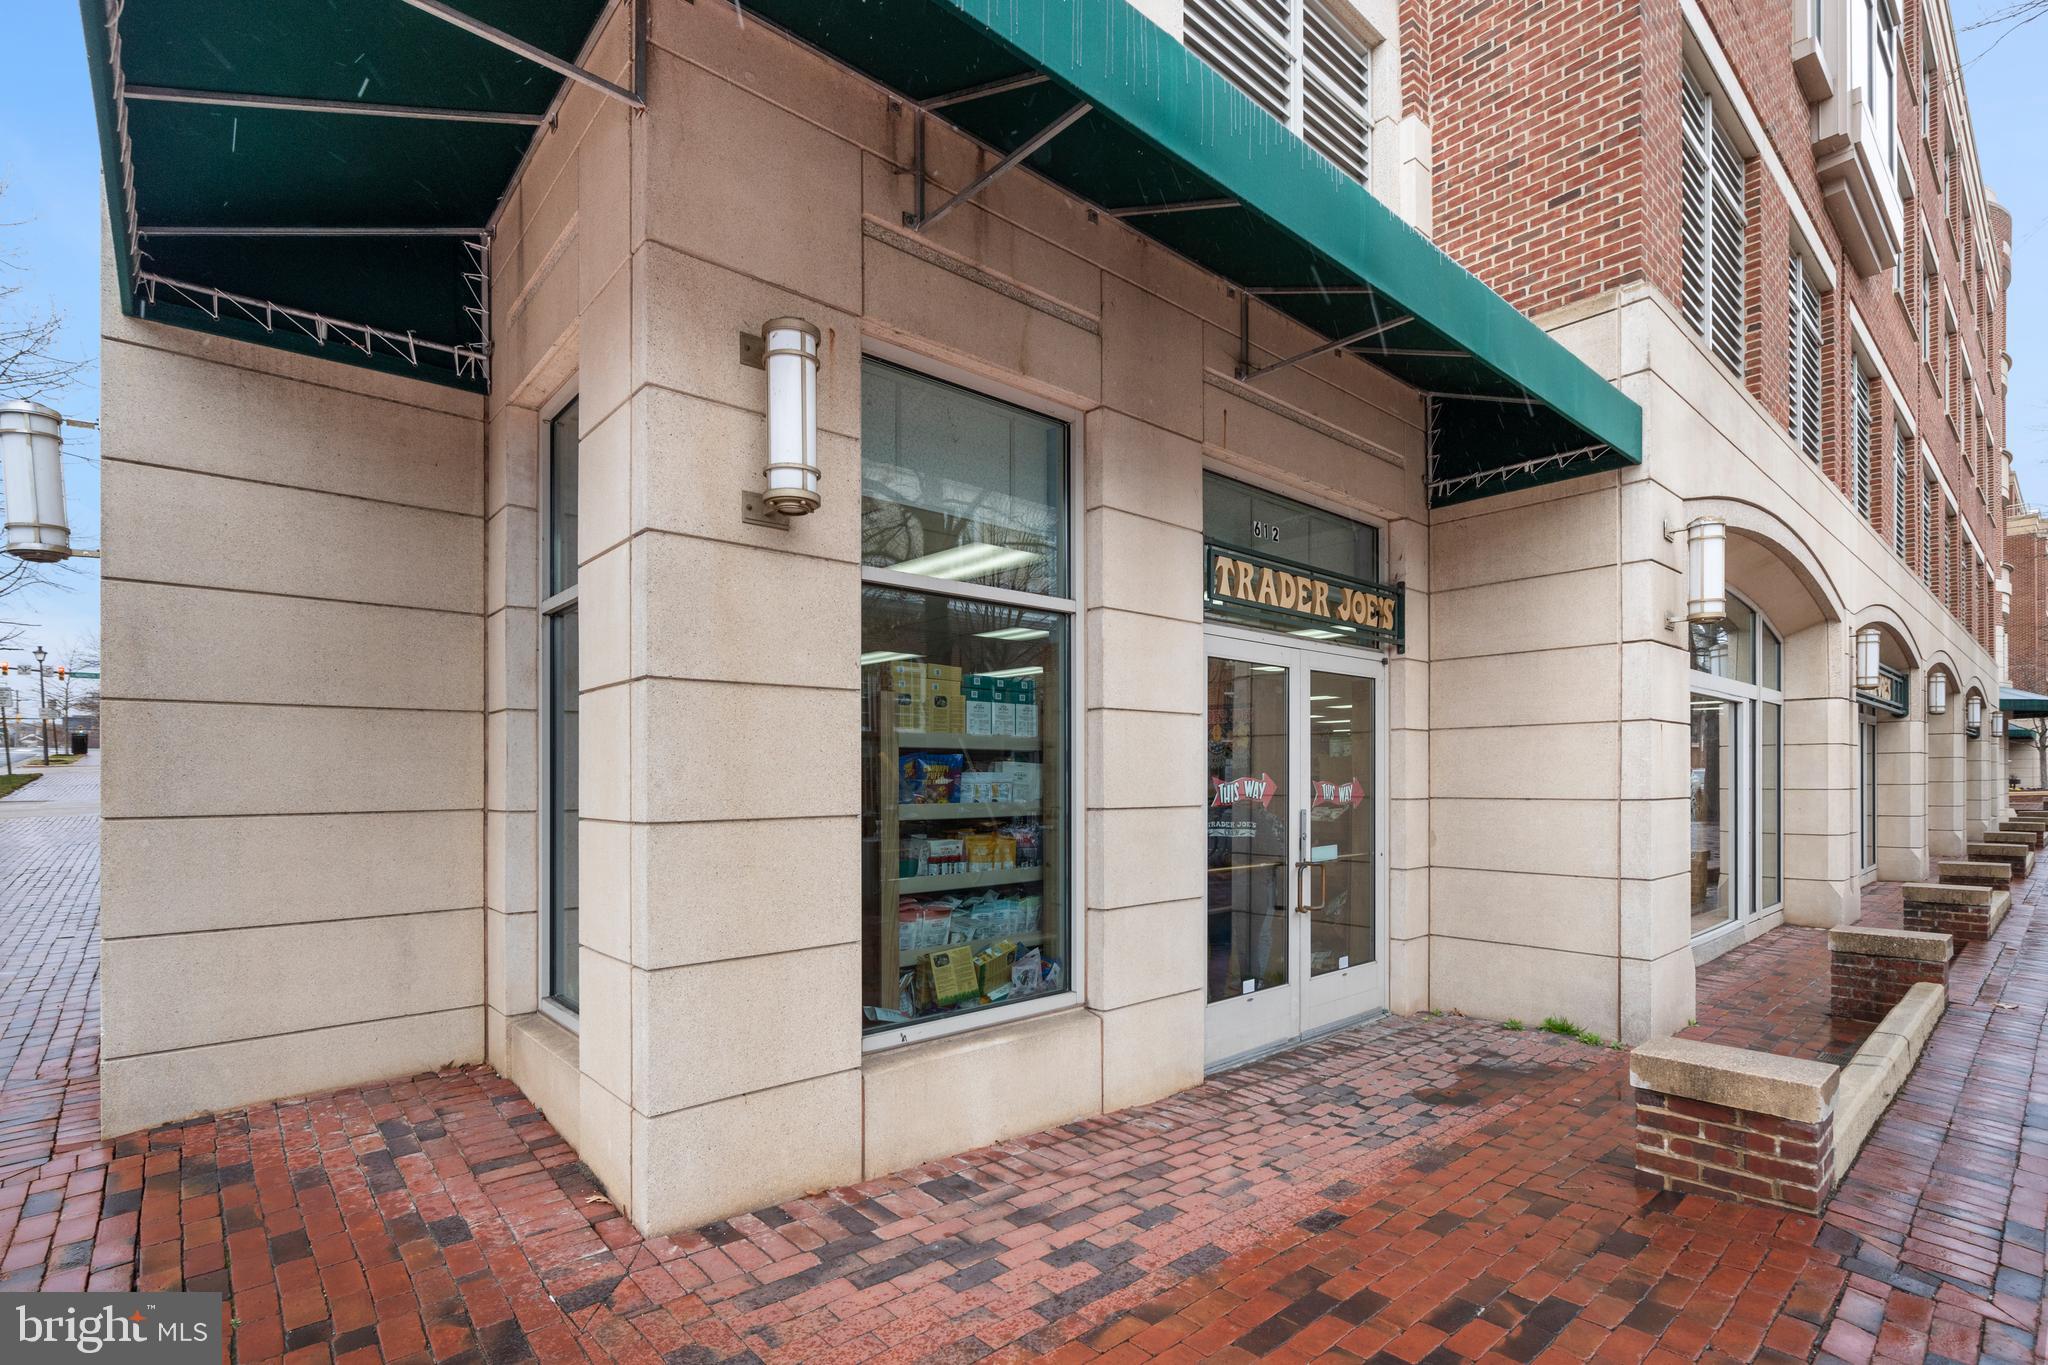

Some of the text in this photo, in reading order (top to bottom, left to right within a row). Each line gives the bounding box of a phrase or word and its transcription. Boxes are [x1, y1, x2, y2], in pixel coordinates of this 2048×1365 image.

[1254, 521, 1279, 543] 612
[1215, 556, 1396, 631] TRADER JOE'S
[1218, 780, 1267, 804] THIS WAY
[1321, 783, 1353, 803] THIS WAY
